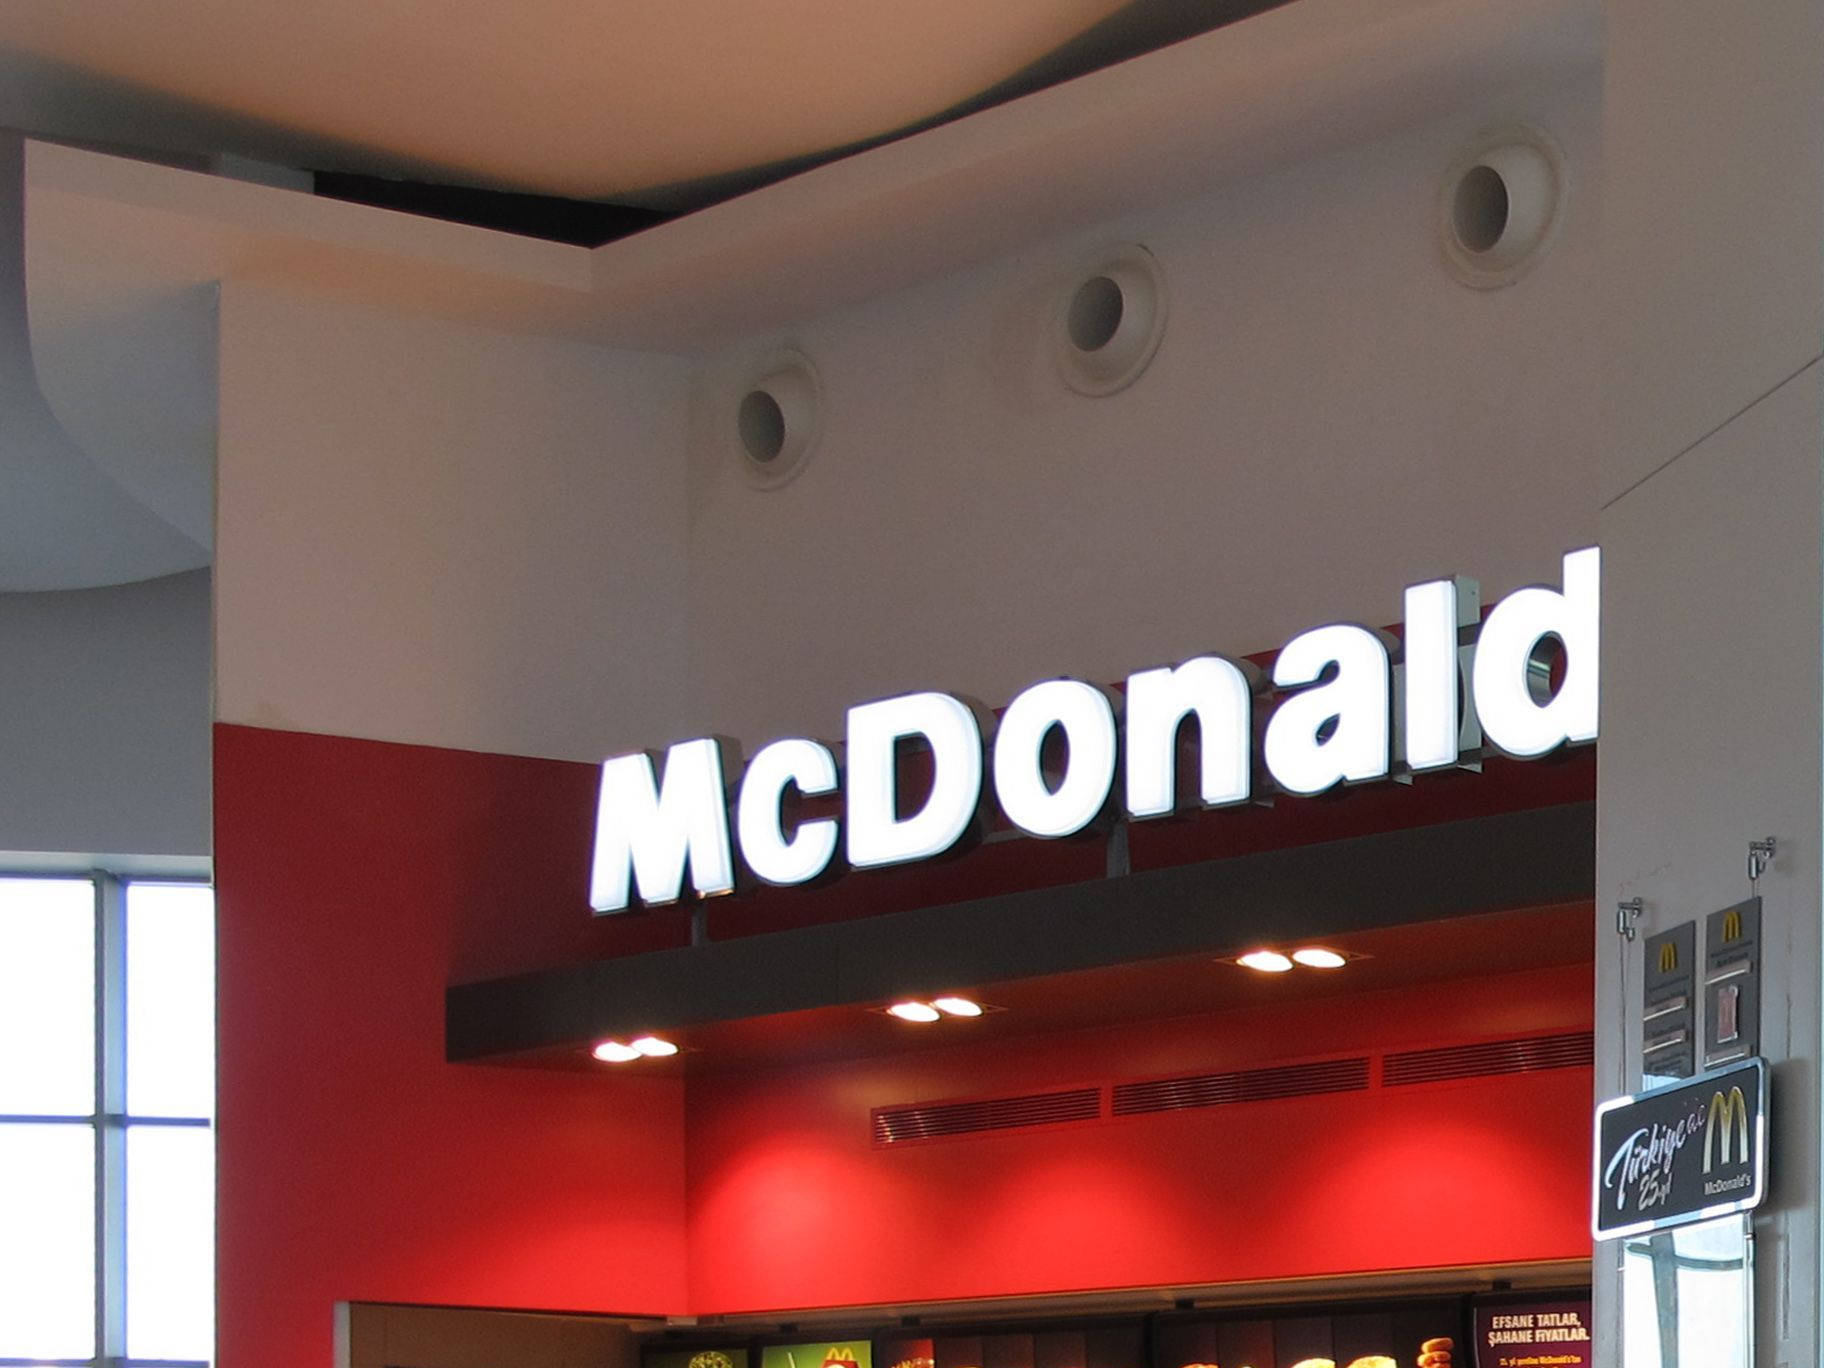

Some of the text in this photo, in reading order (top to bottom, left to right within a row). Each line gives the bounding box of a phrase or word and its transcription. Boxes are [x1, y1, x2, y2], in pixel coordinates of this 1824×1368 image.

[1704, 1174, 1751, 1195] McDonald's
[1492, 1312, 1581, 1329] EFSANE TATLAR,
[1488, 1330, 1533, 1348] ŞAHANE
